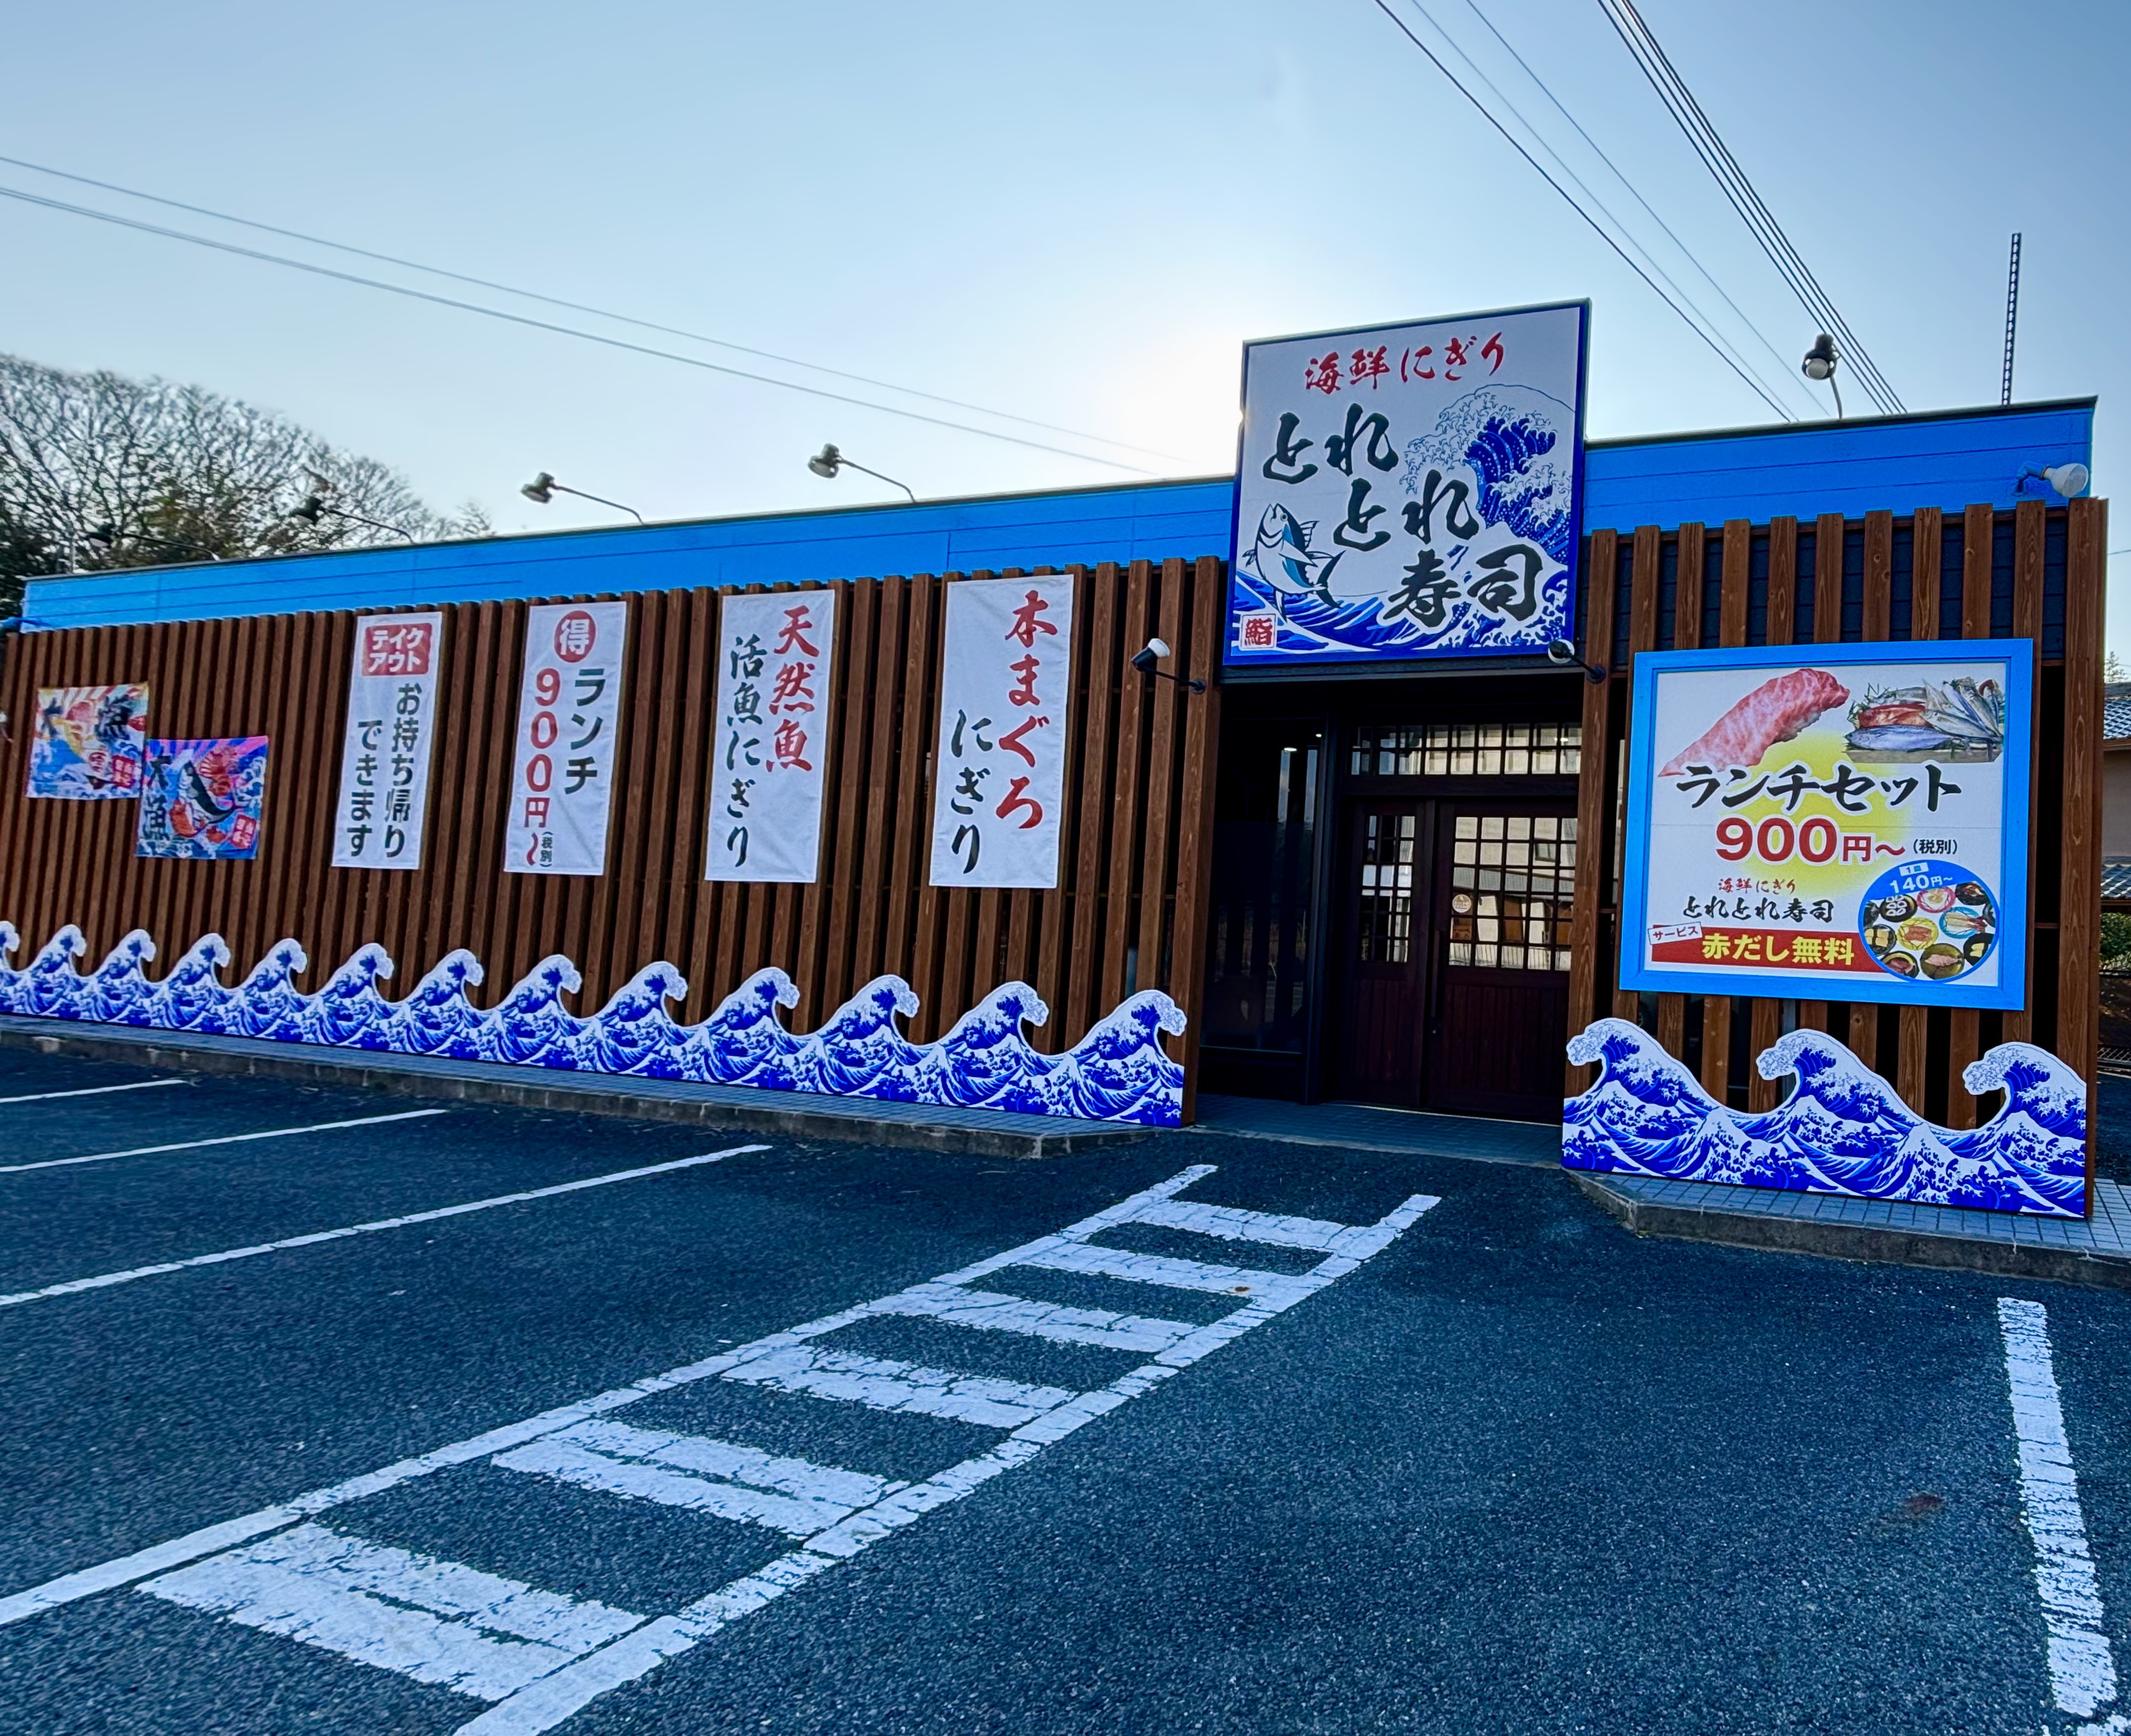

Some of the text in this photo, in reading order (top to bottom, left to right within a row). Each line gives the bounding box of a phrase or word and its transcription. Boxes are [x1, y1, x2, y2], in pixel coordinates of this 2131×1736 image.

[1304, 332, 1503, 394] 海鮮にぎり
[1263, 403, 1398, 484] とれ
[1333, 469, 1479, 551] とれ
[1383, 543, 1544, 628] 寿司
[368, 650, 421, 673] アウト
[372, 628, 424, 650] テイク
[558, 619, 590, 655] 得
[1244, 618, 1273, 645] 鮨
[766, 605, 820, 772] 天然魚
[996, 590, 1058, 829] 本まぐろ
[565, 668, 605, 794] ランチ
[727, 634, 767, 867] 活魚にぎり
[347, 720, 382, 857] できます
[385, 683, 422, 857] お持ち帰り
[950, 709, 993, 874] にぎり
[1676, 764, 1962, 812] ランチセット
[1683, 896, 1834, 922] とれとれ寿司
[1719, 878, 1796, 894] 海鮮にぎり
[1652, 925, 1699, 940] サービス
[1702, 933, 1855, 965] 赤だし無料
